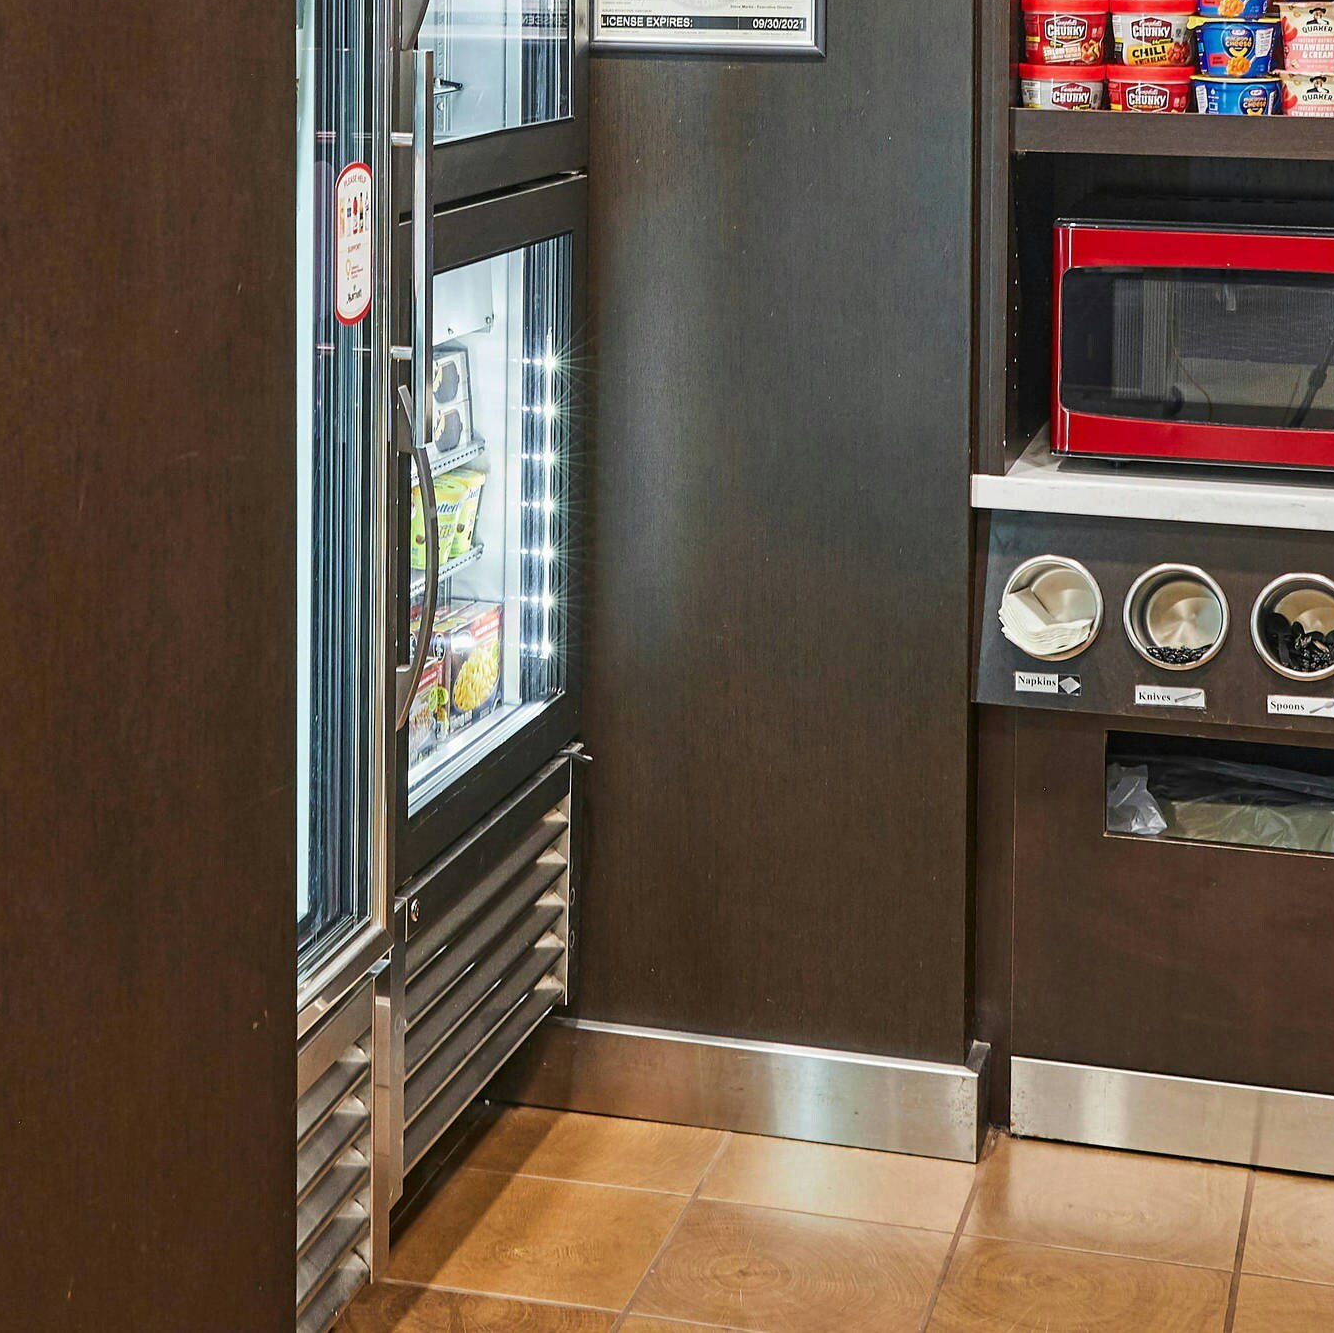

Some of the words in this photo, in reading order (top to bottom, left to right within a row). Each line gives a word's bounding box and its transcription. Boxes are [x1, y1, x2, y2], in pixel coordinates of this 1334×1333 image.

[601, 15, 644, 28] LICENSE
[646, 16, 693, 28] EXPIRES:
[752, 18, 804, 29] 09/30/2021
[1047, 25, 1085, 37] CHUNKY
[1132, 26, 1171, 38] CHUNKY
[1301, 25, 1333, 33] QUAKER
[1132, 46, 1166, 58] CHILI
[1310, 50, 1334, 58] CREAM
[1052, 92, 1090, 104] CHUNKY
[1128, 95, 1167, 106] CHUNKY
[1301, 93, 1333, 101] QUAKER
[1017, 675, 1057, 689] Napkins
[1138, 691, 1171, 703] Knives
[1269, 700, 1305, 713] Spoons
